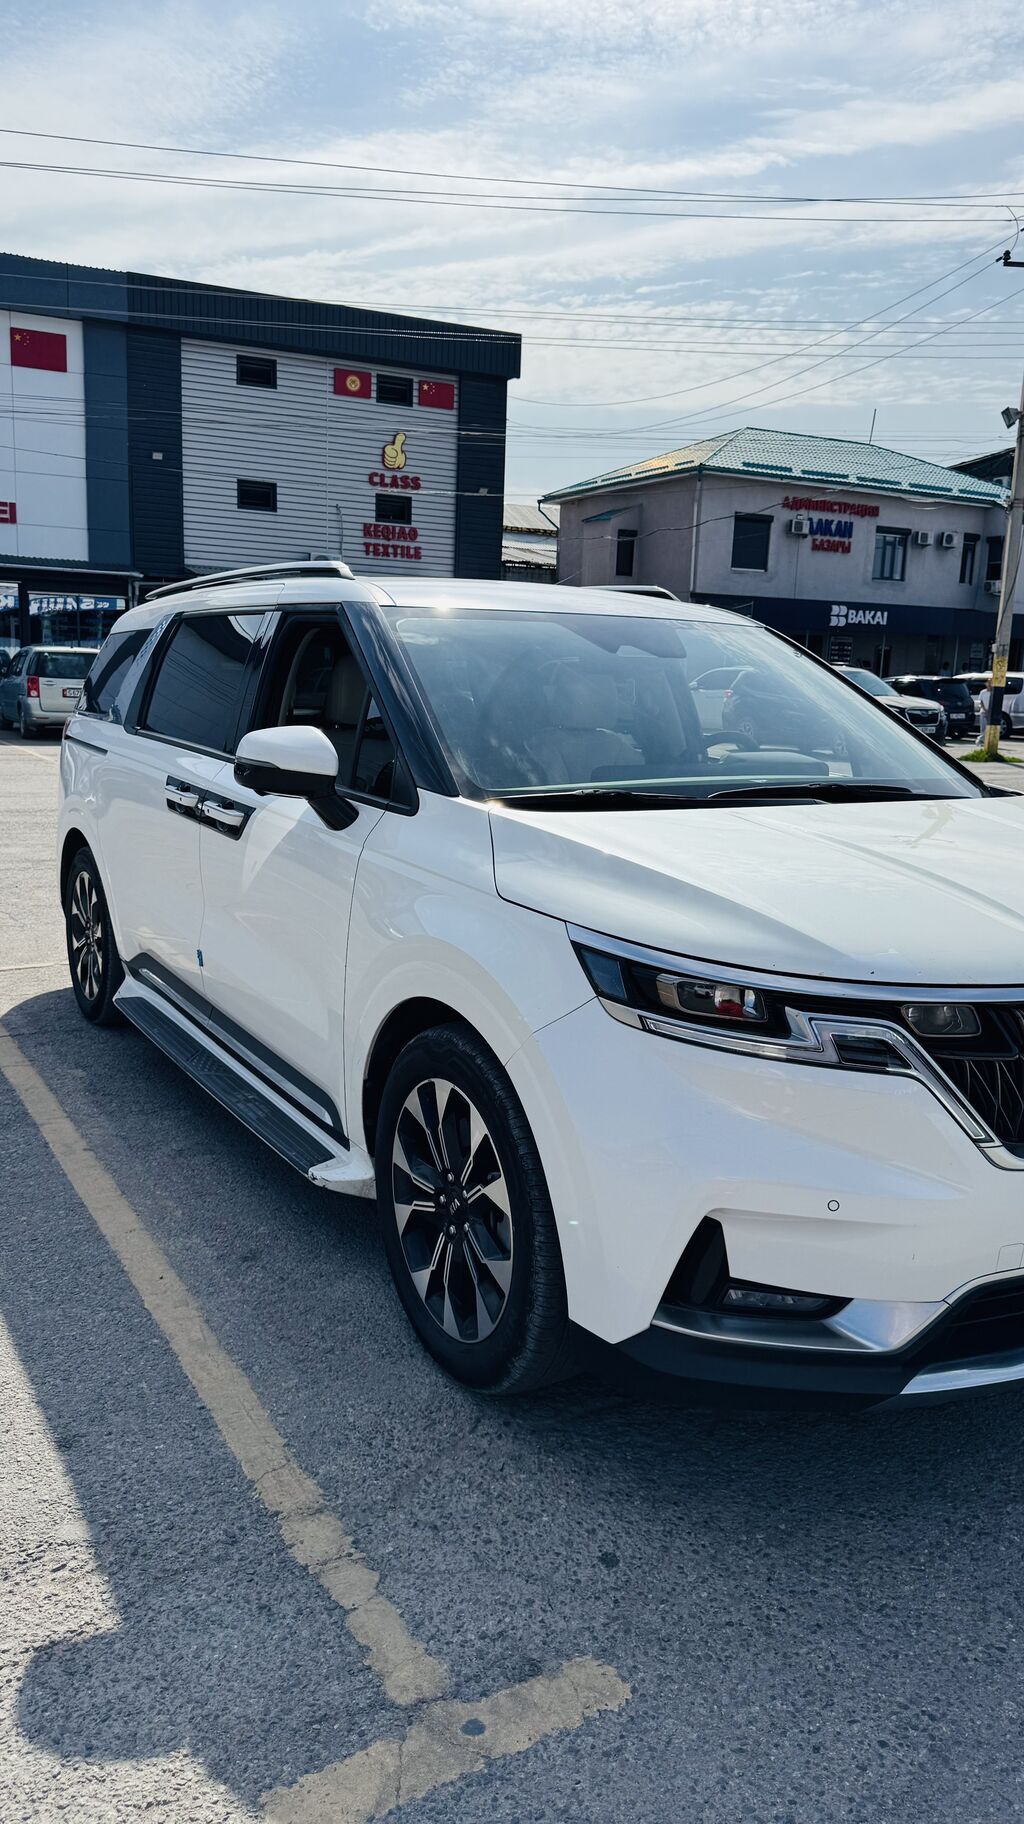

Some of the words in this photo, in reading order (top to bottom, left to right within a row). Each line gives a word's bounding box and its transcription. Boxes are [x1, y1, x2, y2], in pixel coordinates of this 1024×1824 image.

[368, 471, 421, 490] CLASS
[363, 522, 418, 541] KEQIAO
[363, 542, 422, 560] TEXTILE
[811, 538, 851, 554] БАЗАРЫ
[847, 609, 888, 625] BAKAI
